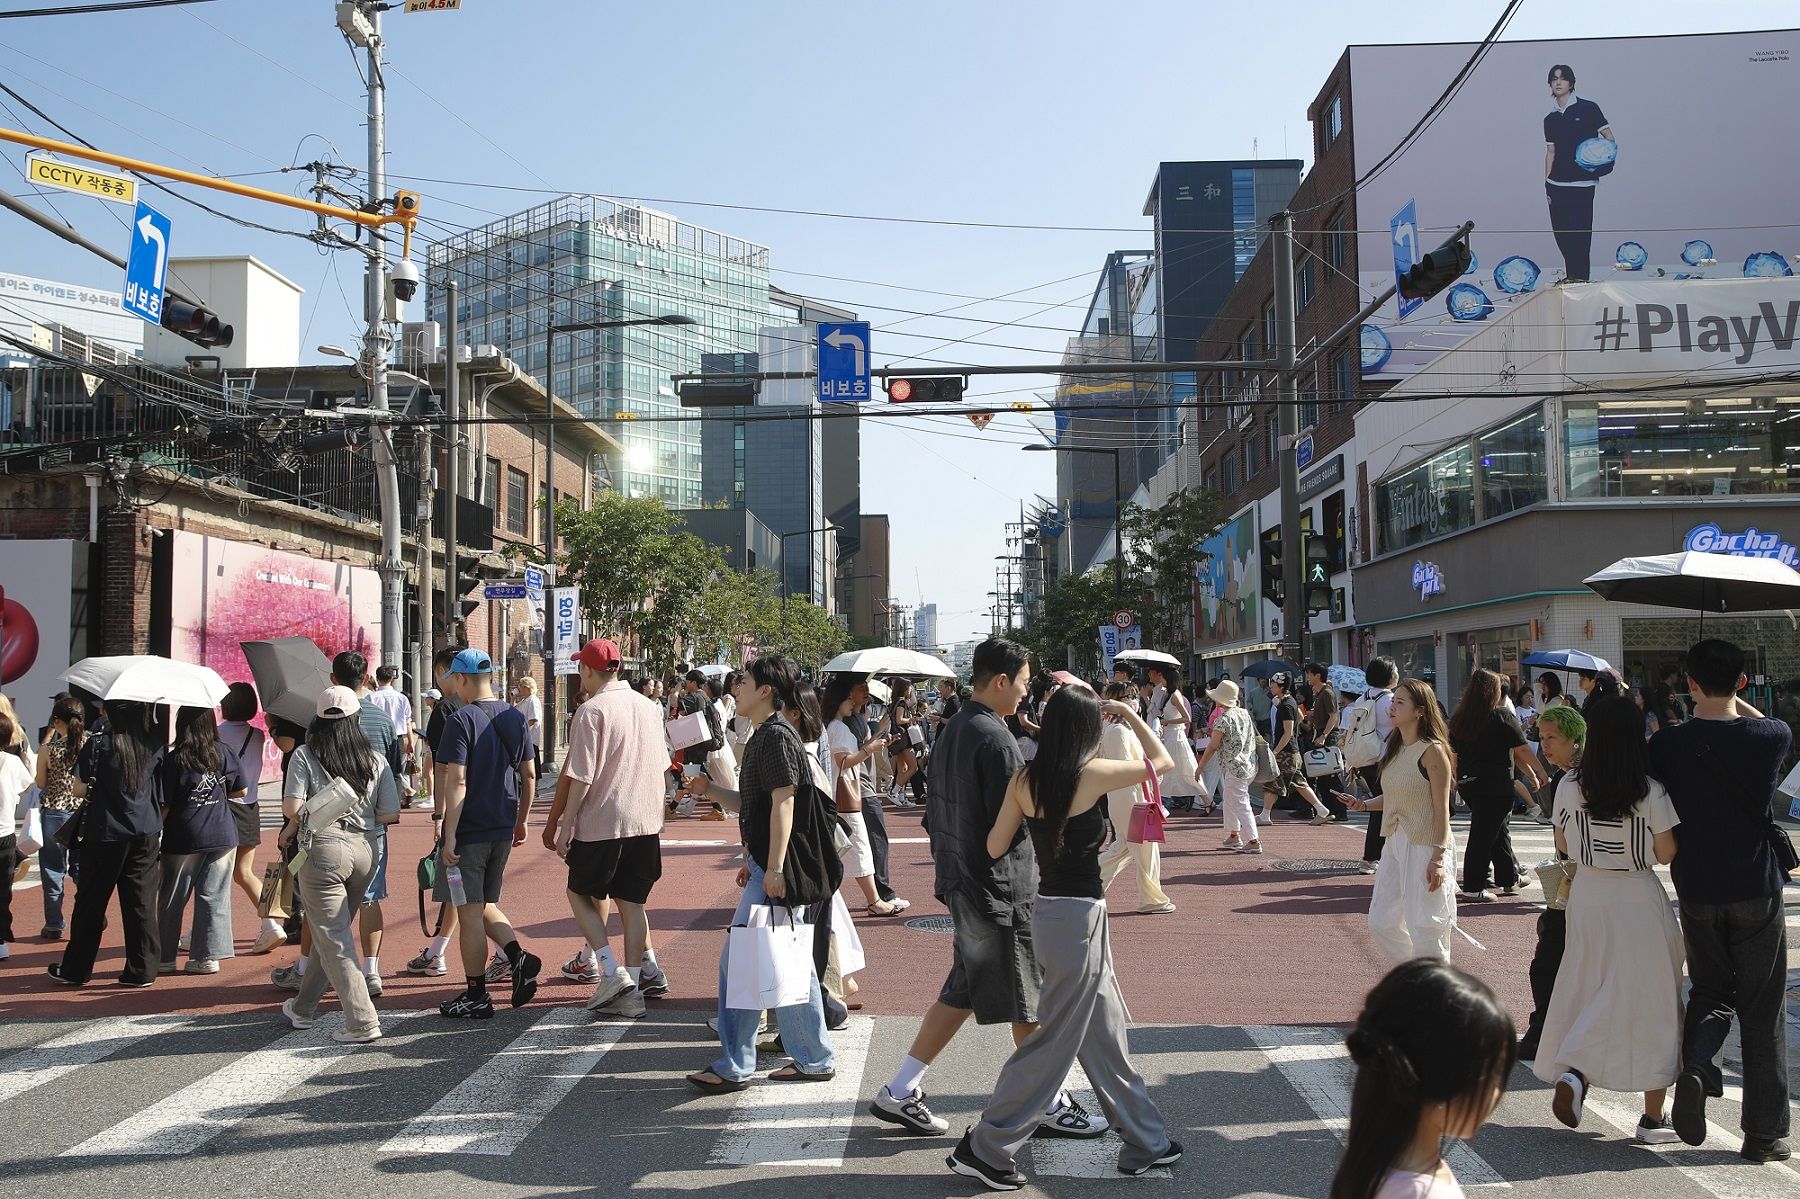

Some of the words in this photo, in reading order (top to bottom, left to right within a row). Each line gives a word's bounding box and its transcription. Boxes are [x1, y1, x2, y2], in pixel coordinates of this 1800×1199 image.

[39, 165, 83, 185] CCTV
[87, 175, 126, 196] 작동중
[1175, 183, 1221, 200] 三和
[125, 281, 160, 319] 비보호
[821, 379, 868, 398] 비보호
[1321, 463, 1338, 481] SQUARE
[1117, 614, 1130, 624] 30
